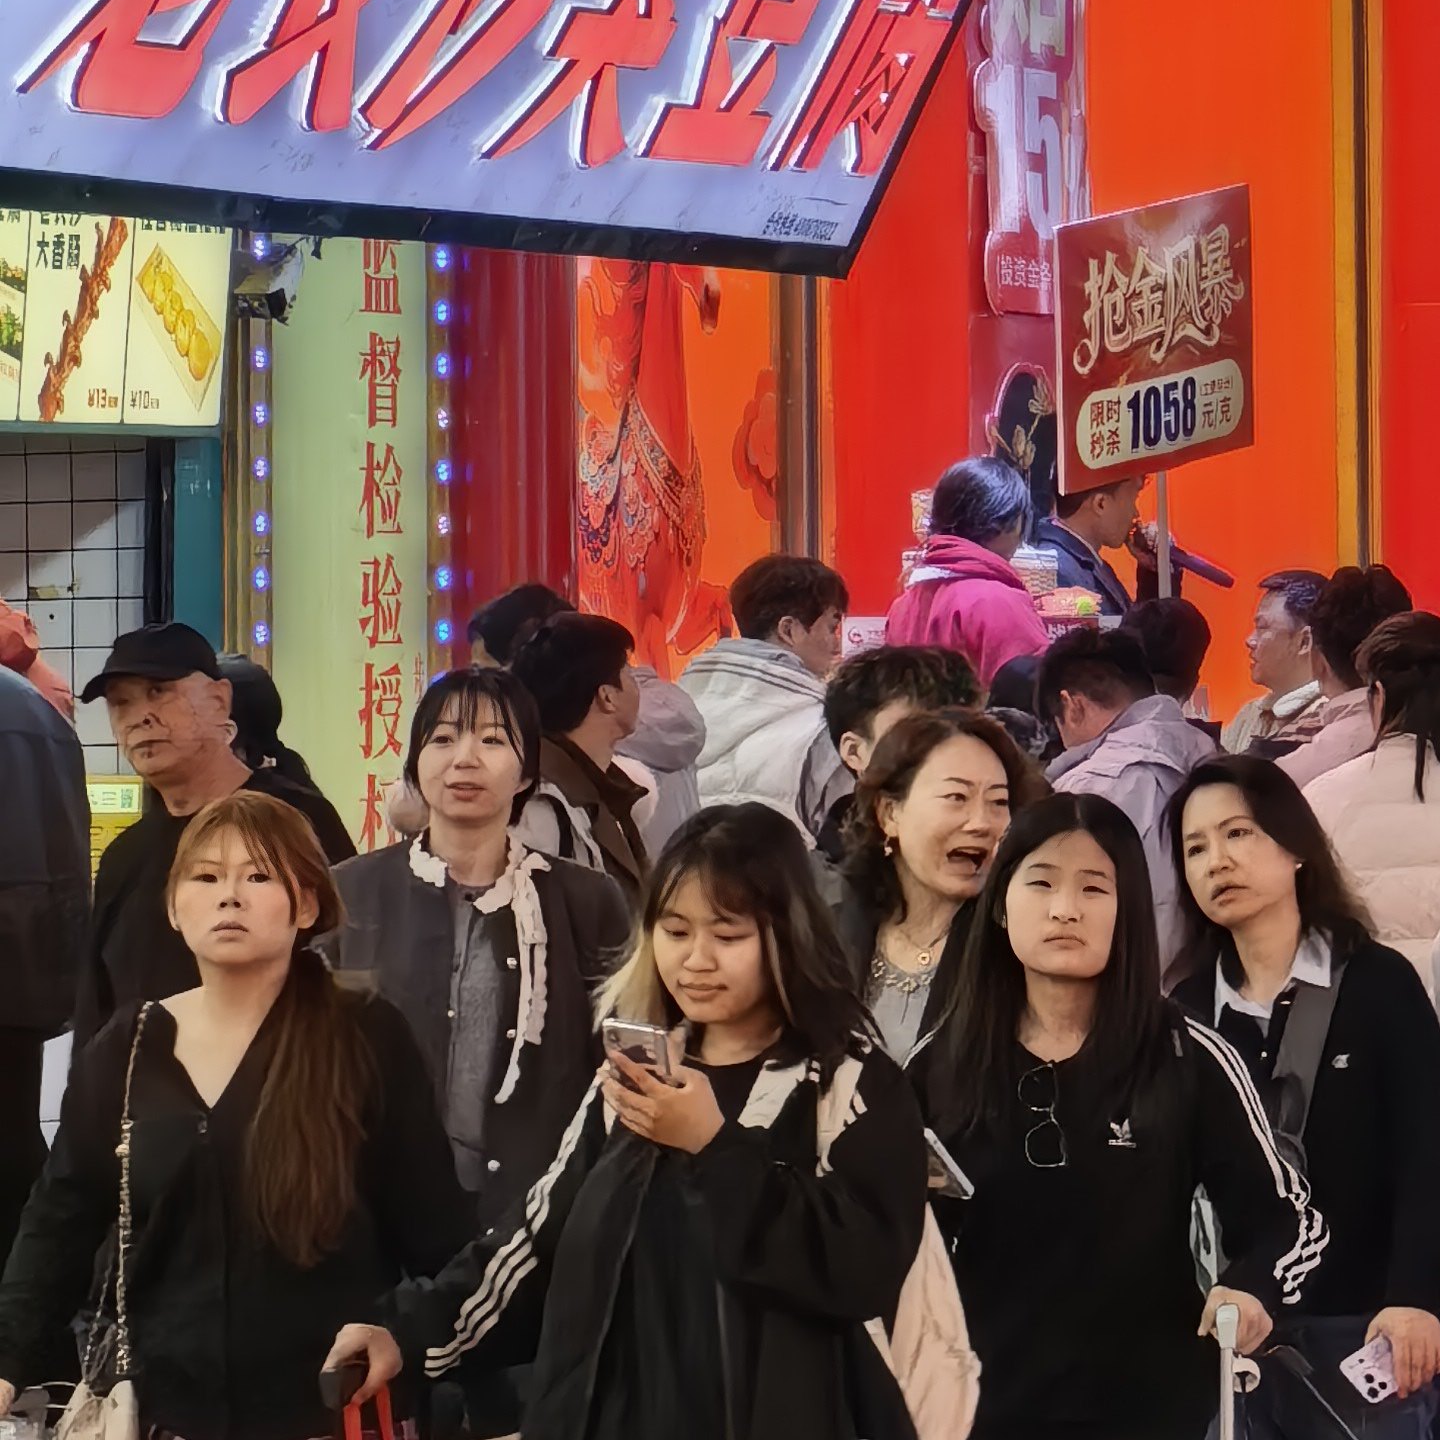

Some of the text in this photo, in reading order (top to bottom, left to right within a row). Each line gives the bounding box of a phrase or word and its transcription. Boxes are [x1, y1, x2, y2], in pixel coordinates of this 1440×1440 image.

[1073, 223, 1246, 376] 抢金风暴
[1126, 375, 1197, 455] 1058
